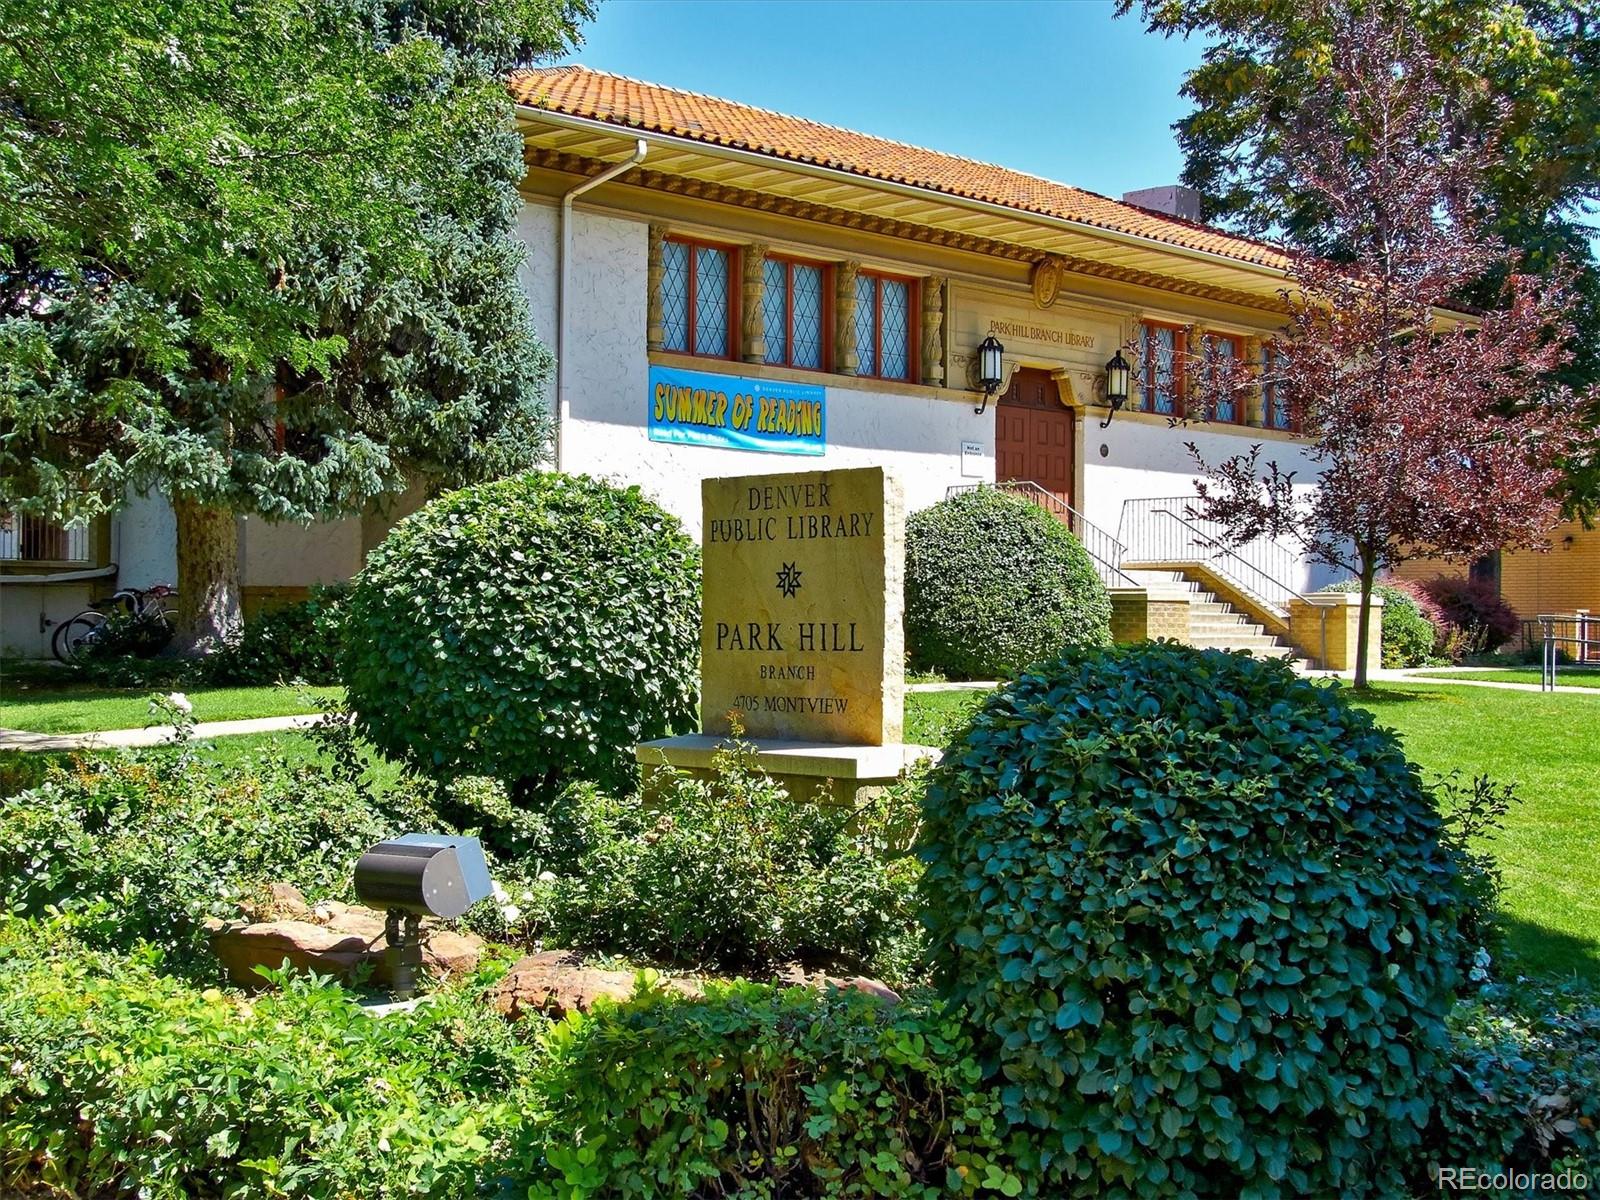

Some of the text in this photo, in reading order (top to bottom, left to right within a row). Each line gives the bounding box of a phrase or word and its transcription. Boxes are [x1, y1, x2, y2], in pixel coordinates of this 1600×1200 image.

[990, 320, 1095, 348] PARK HILL BRANCH LIBRARY
[654, 382, 728, 428] SUMMER
[731, 392, 753, 431] OF
[748, 483, 831, 511] DENVER
[711, 512, 874, 543] PUBLIC LIBRARY
[716, 622, 865, 652] PARK HILL
[760, 665, 816, 681] BRANCH
[733, 695, 848, 714] 4705 MONTVIEW
